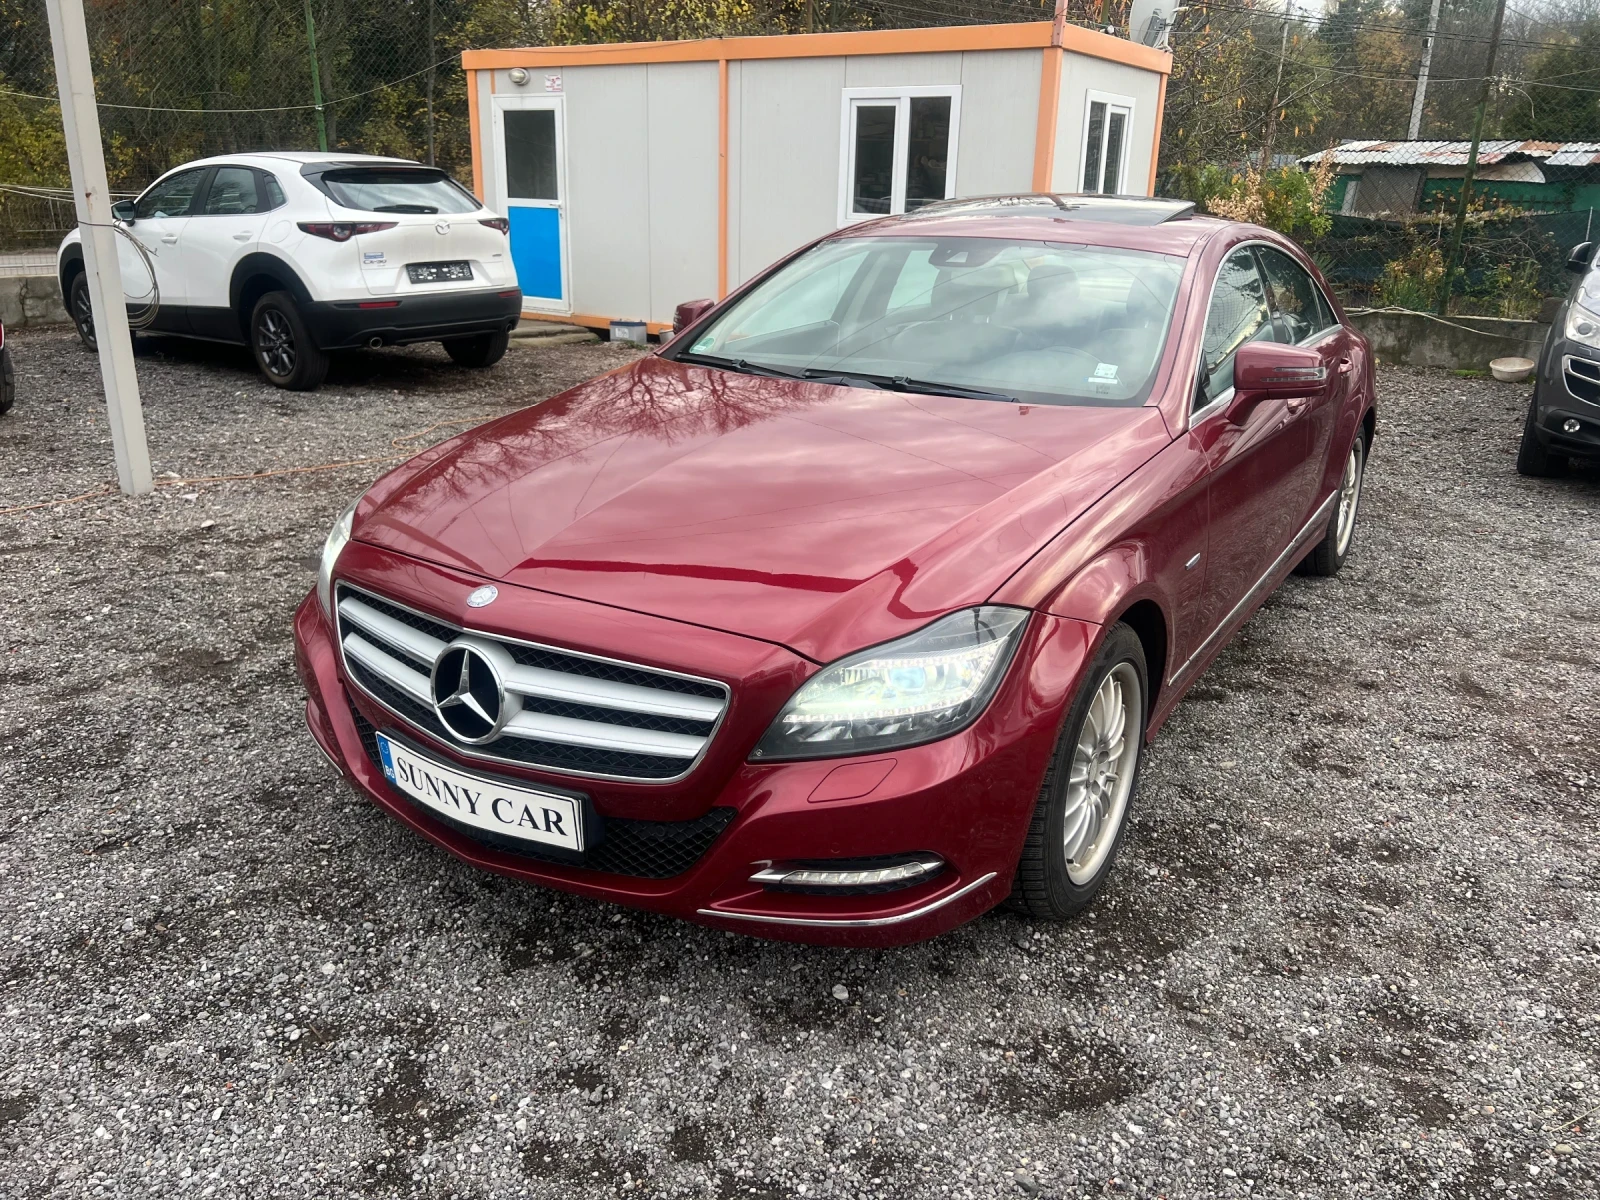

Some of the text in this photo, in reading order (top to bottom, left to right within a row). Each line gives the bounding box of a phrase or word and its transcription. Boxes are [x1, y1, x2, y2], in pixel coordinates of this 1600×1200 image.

[384, 764, 396, 779] BG
[396, 756, 569, 837] SUNNY CAR
